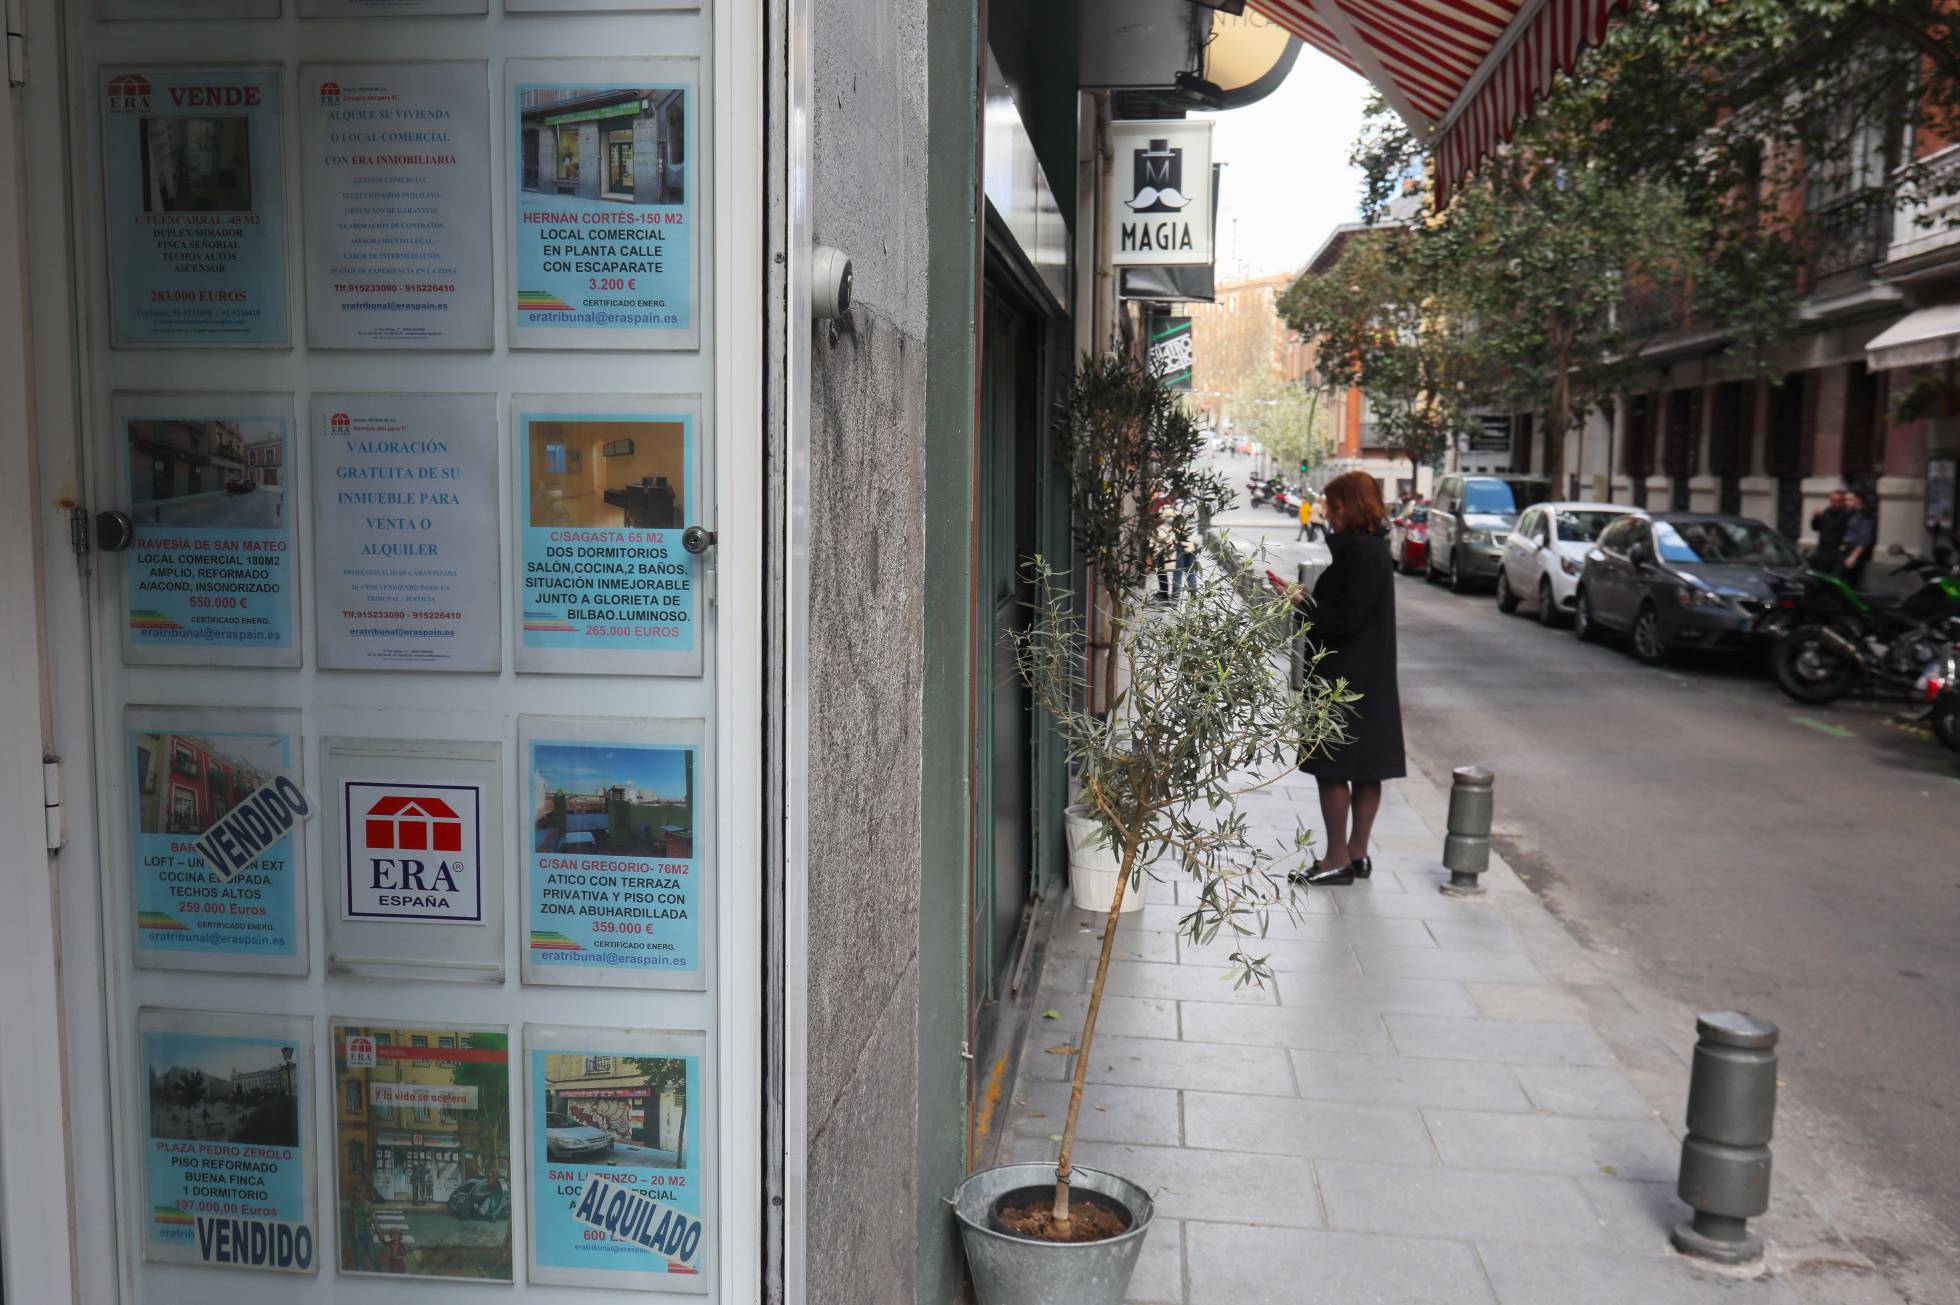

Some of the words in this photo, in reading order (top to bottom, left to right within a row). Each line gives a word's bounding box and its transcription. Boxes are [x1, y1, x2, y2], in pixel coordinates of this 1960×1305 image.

[110, 97, 151, 109] ERA
[168, 86, 261, 108] VENDE
[321, 96, 341, 104] ERA
[328, 111, 378, 121] ALQUILE
[379, 111, 393, 120] SU
[396, 110, 451, 120] VIVIENDA
[341, 133, 379, 143] LOCAL
[381, 133, 451, 143] COMERCIAL
[324, 155, 349, 166] CON
[352, 155, 374, 165] ERA
[376, 155, 457, 165] INMOBILIARIA
[523, 210, 578, 225] HERNÁN
[582, 211, 661, 225] CORTÉS-150
[664, 213, 684, 225] M2
[540, 229, 585, 240] LOCAL
[588, 229, 666, 241] COMERCIAL
[1121, 222, 1192, 252] MAGIA
[157, 240, 187, 250] FINCA
[190, 238, 240, 250] SEÑORIAL
[163, 252, 202, 262] TECHOS
[204, 252, 238, 262] ALTOS
[543, 245, 561, 256] EN
[565, 245, 617, 257] PLANTA
[620, 246, 663, 257] CALLE
[174, 263, 226, 273] ASCENSOR
[543, 261, 572, 273] CON
[575, 262, 663, 273] ESCAPARATE
[589, 279, 624, 290] 3.200
[627, 279, 637, 290] €
[199, 290, 247, 302] EUROS
[341, 301, 448, 311] eratribunal@eraspain.es
[582, 299, 636, 307] CERTIFICADO
[637, 300, 667, 308] ENERG.
[528, 312, 679, 325] eratribunal@eraspain.es
[346, 438, 448, 453] VALORACIÓN
[336, 466, 414, 480] GRATUITA
[418, 467, 438, 479] DE
[440, 467, 460, 479] SU
[338, 493, 416, 505] INMUEBLE
[419, 493, 460, 505] PARA
[366, 518, 416, 530] VENTA
[419, 518, 432, 530] O
[550, 531, 625, 544] C/SAGASTA
[628, 532, 643, 543] 65
[646, 533, 664, 544] M2
[194, 540, 210, 550] DE
[213, 540, 239, 550] SAN
[242, 541, 287, 551] MATEO
[361, 543, 439, 557] ALQUILER
[546, 547, 573, 558] DOS
[577, 547, 668, 559] DORMITORIOS
[137, 554, 176, 564] LOCAL
[178, 555, 243, 566] COMERCIAL
[246, 556, 280, 567] 180M2
[149, 568, 195, 580] AMPLIO,
[197, 569, 269, 579] REFORMADO
[527, 560, 635, 575] SALÓN,COCINA,2
[638, 561, 688, 575] BAÑOS.
[195, 582, 280, 594] INSONORIZADO
[526, 576, 593, 589] SITUACIÓN
[597, 578, 691, 591] INMEJORABLE
[189, 596, 236, 609] 550.000
[239, 597, 248, 608] €
[535, 594, 577, 604] JUNTO
[581, 595, 590, 604] A
[593, 594, 660, 606] GLORIETA
[663, 595, 681, 606] DE
[191, 616, 240, 625] CERTIFICADO
[141, 627, 281, 642] eratribunal@eraspain.es
[585, 625, 631, 636] 265.000
[634, 626, 680, 637] EUROS
[195, 775, 308, 877] VENDIDO
[144, 856, 175, 867] LOFT
[187, 857, 205, 868] UN
[261, 860, 286, 872] EXT
[539, 858, 577, 870] C/SAN
[657, 863, 688, 877] 76M2
[159, 871, 206, 883] COCINA
[209, 873, 271, 885] EIPADA
[547, 874, 586, 886] ATICO
[589, 876, 616, 887] CON
[620, 877, 680, 890] TERRAZA
[169, 886, 218, 898] TECHOS
[221, 888, 262, 900] ALTOS
[543, 888, 609, 902] PRIVATIVA
[613, 892, 621, 902] Y
[624, 893, 654, 904] PISO
[657, 894, 685, 905] CON
[179, 901, 225, 913] 259.000
[229, 904, 266, 915] Euros
[379, 895, 449, 909] ESPAÑA
[540, 904, 575, 916] ZONA
[578, 905, 688, 920] ABUHARDILLADA
[197, 921, 246, 930] CERTIFICADO
[592, 921, 642, 934] 359.000
[645, 924, 653, 934] €
[148, 931, 286, 947] eratribunal@eraspain.es
[593, 940, 645, 950] CERTIFICADO
[646, 942, 676, 951] ENERG.
[541, 951, 687, 967] eratribunal@eraspain.es
[395, 1090, 415, 1101] vida
[418, 1094, 429, 1103] se
[431, 1094, 467, 1104] acelera
[157, 1142, 194, 1154] PLAZA
[198, 1145, 240, 1157] PEDRO
[242, 1147, 292, 1161] ZEROLO
[171, 1157, 199, 1168] PISO
[202, 1159, 278, 1174] REFORMADO
[185, 1172, 227, 1185] BUENA
[229, 1174, 265, 1187] FINCA
[548, 1170, 574, 1181] SAN
[577, 1172, 638, 1184] LENZO
[651, 1175, 664, 1186] 20
[667, 1176, 686, 1187] M2
[183, 1186, 189, 1196] 1
[192, 1187, 268, 1202] DORMITORIO
[240, 1205, 278, 1218] Euros
[575, 1178, 702, 1263] ALQUILADO
[583, 1230, 606, 1241] 600
[196, 1216, 313, 1270] VENDIDO
